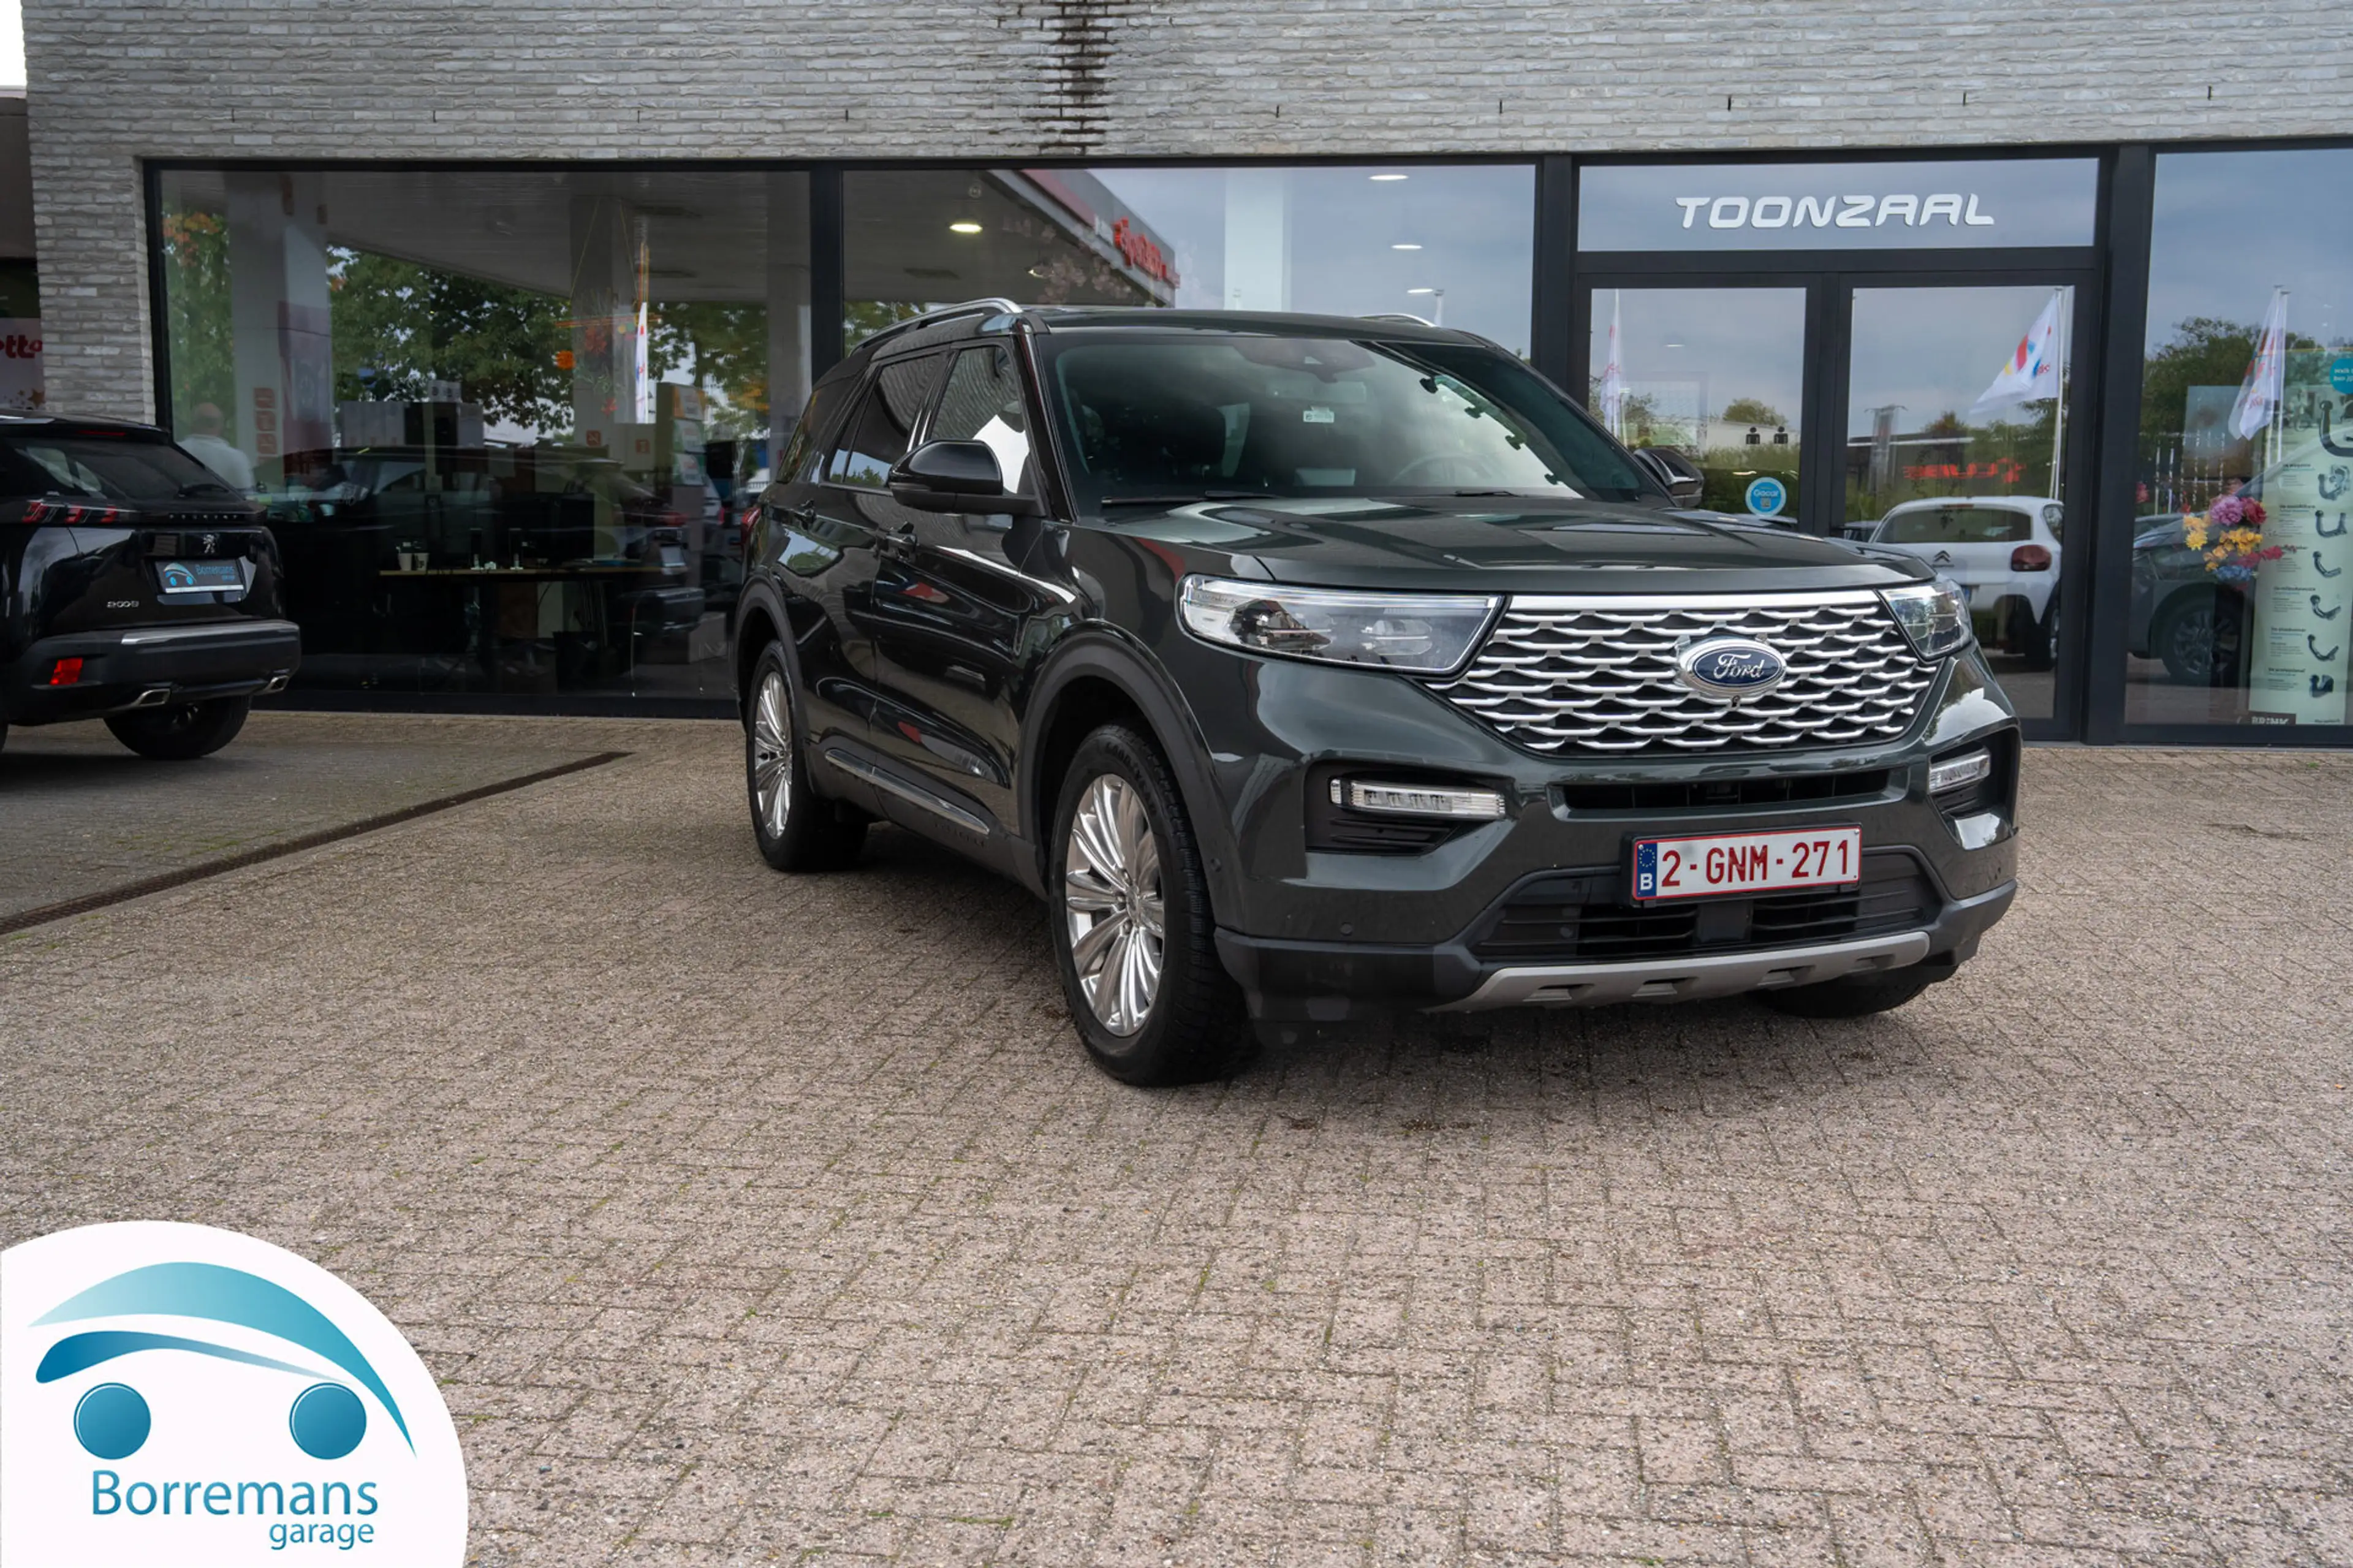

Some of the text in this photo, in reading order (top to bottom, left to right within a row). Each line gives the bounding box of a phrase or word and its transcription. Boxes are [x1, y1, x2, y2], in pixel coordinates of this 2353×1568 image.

[1675, 194, 1995, 228] TOONZAAL
[1713, 653, 1765, 679] Ford
[1661, 839, 1849, 887] 2-GNM-271
[1640, 873, 1653, 890] B
